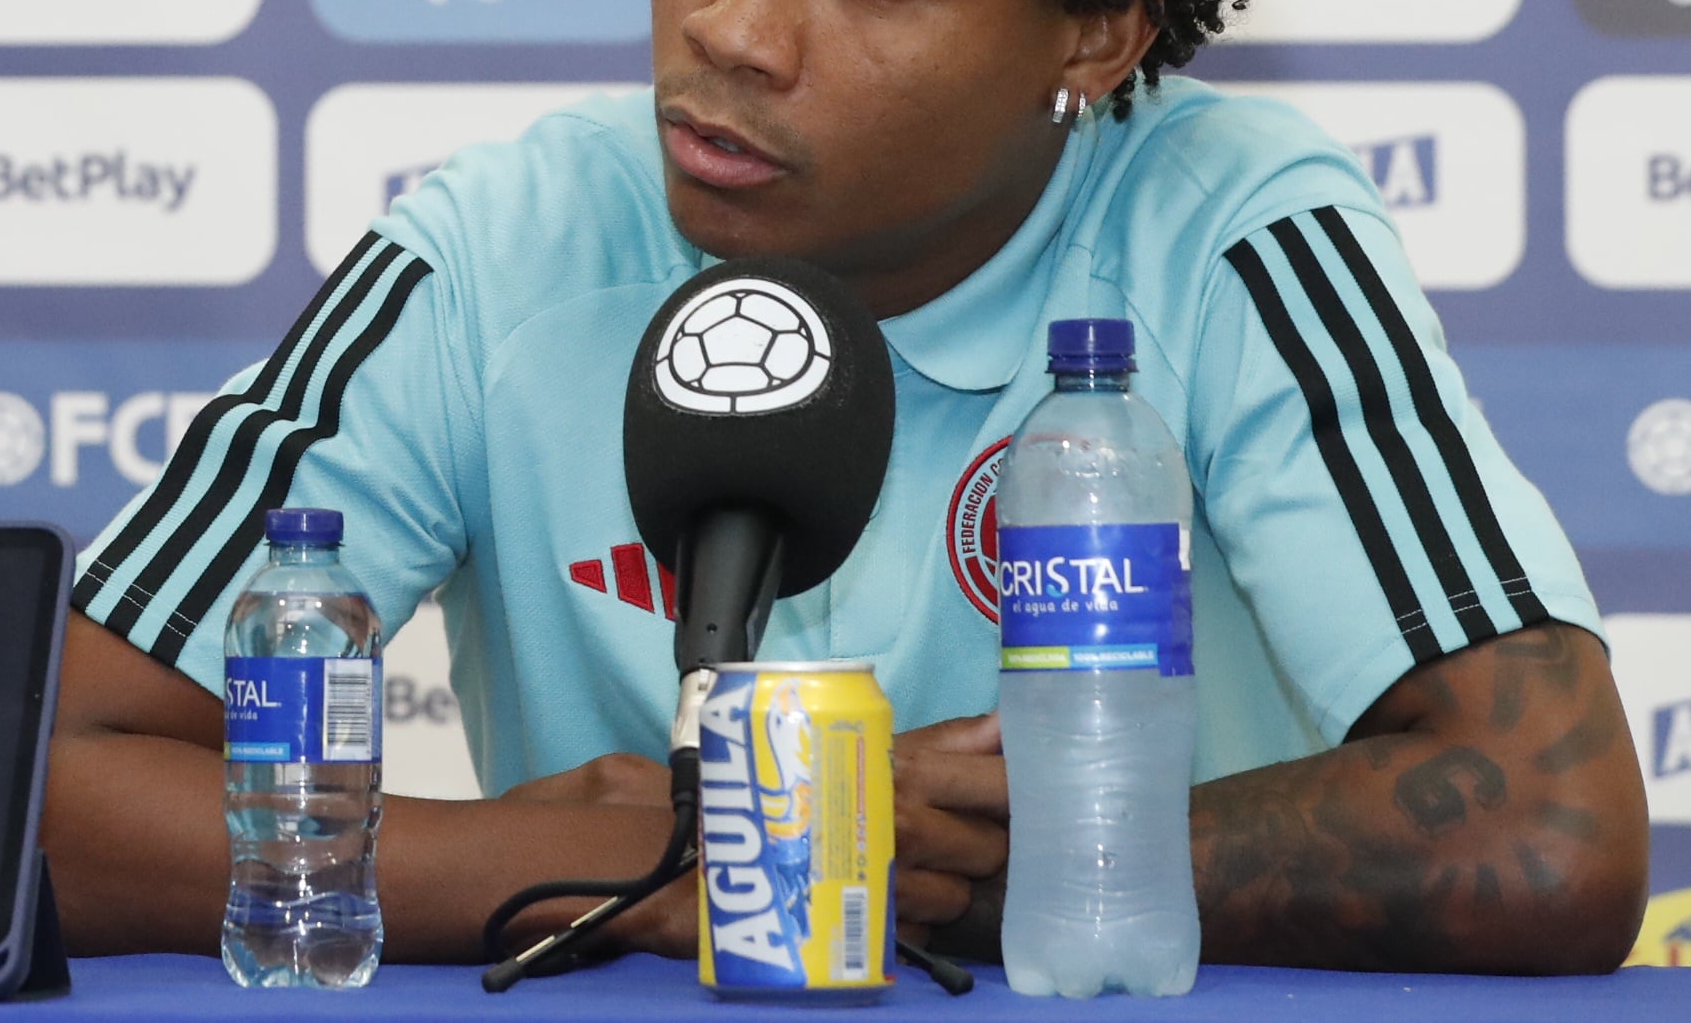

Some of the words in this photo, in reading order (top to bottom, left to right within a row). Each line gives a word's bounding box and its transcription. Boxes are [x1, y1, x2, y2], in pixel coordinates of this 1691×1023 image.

[961, 472, 994, 554] FEDERACION
[1000, 556, 1144, 597] CRISTAL
[1025, 600, 1056, 618] agua
[1062, 597, 1079, 613] de
[699, 682, 796, 971] AGUILA
